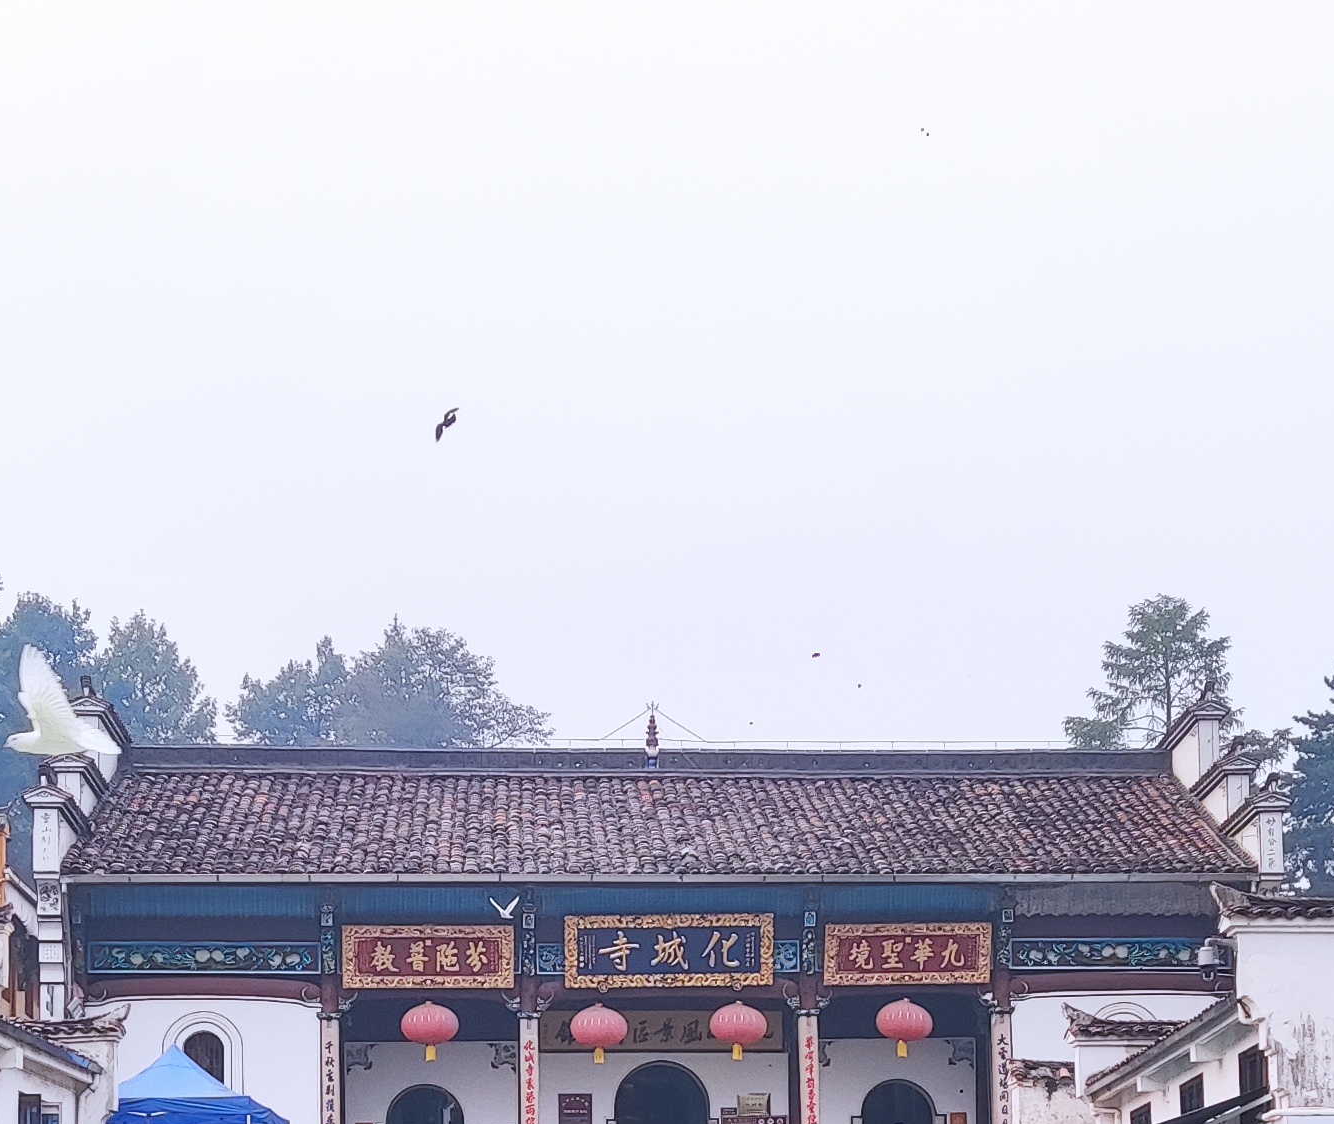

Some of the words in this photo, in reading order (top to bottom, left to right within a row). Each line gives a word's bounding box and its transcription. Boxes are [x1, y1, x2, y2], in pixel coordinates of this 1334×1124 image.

[598, 930, 741, 972] 化城寺
[848, 938, 965, 971] 九華聖境
